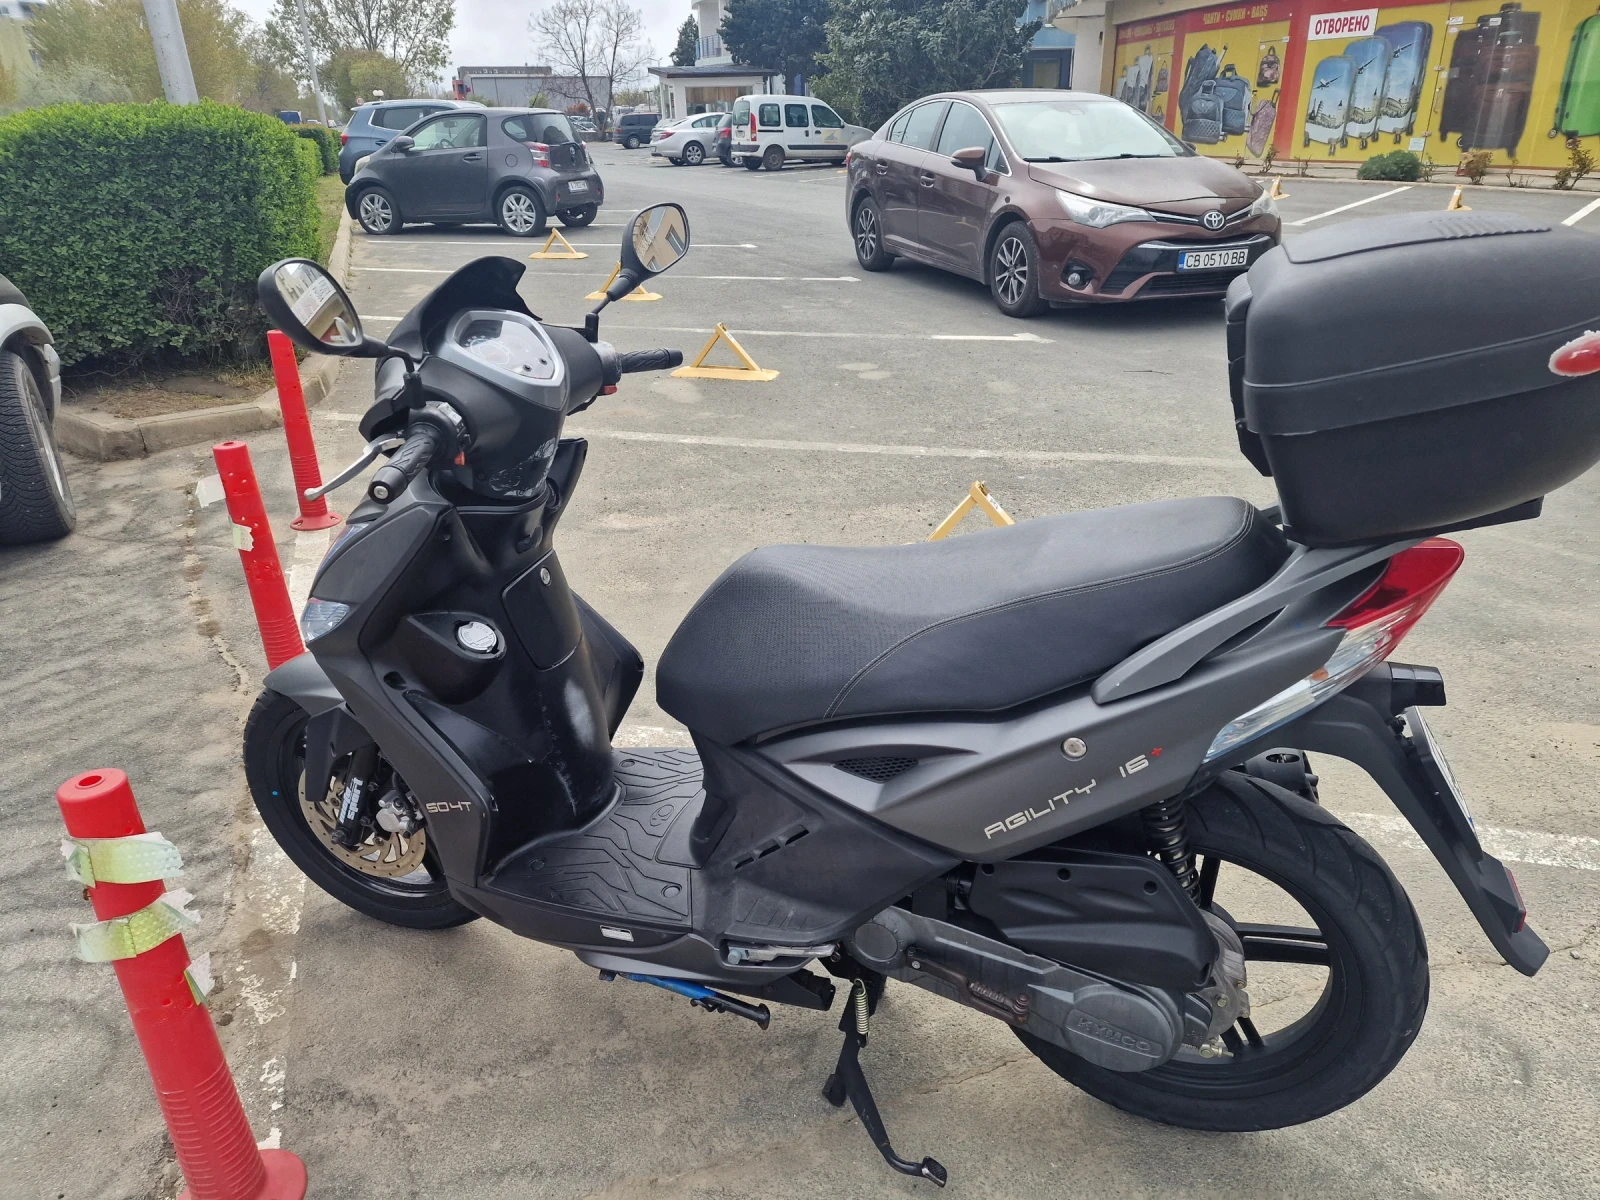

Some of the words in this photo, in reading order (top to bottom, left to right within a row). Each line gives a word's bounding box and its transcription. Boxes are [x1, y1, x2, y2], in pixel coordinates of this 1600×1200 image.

[1251, 5, 1268, 19] BAGS
[1314, 15, 1370, 36] ОТВОРЕНО
[1186, 254, 1201, 268] CB
[1203, 252, 1230, 267] 0510
[1230, 251, 1246, 265] BB
[347, 777, 364, 821] sport
[984, 778, 1097, 839] AGILITY
[1078, 1017, 1152, 1051] KYMCO
